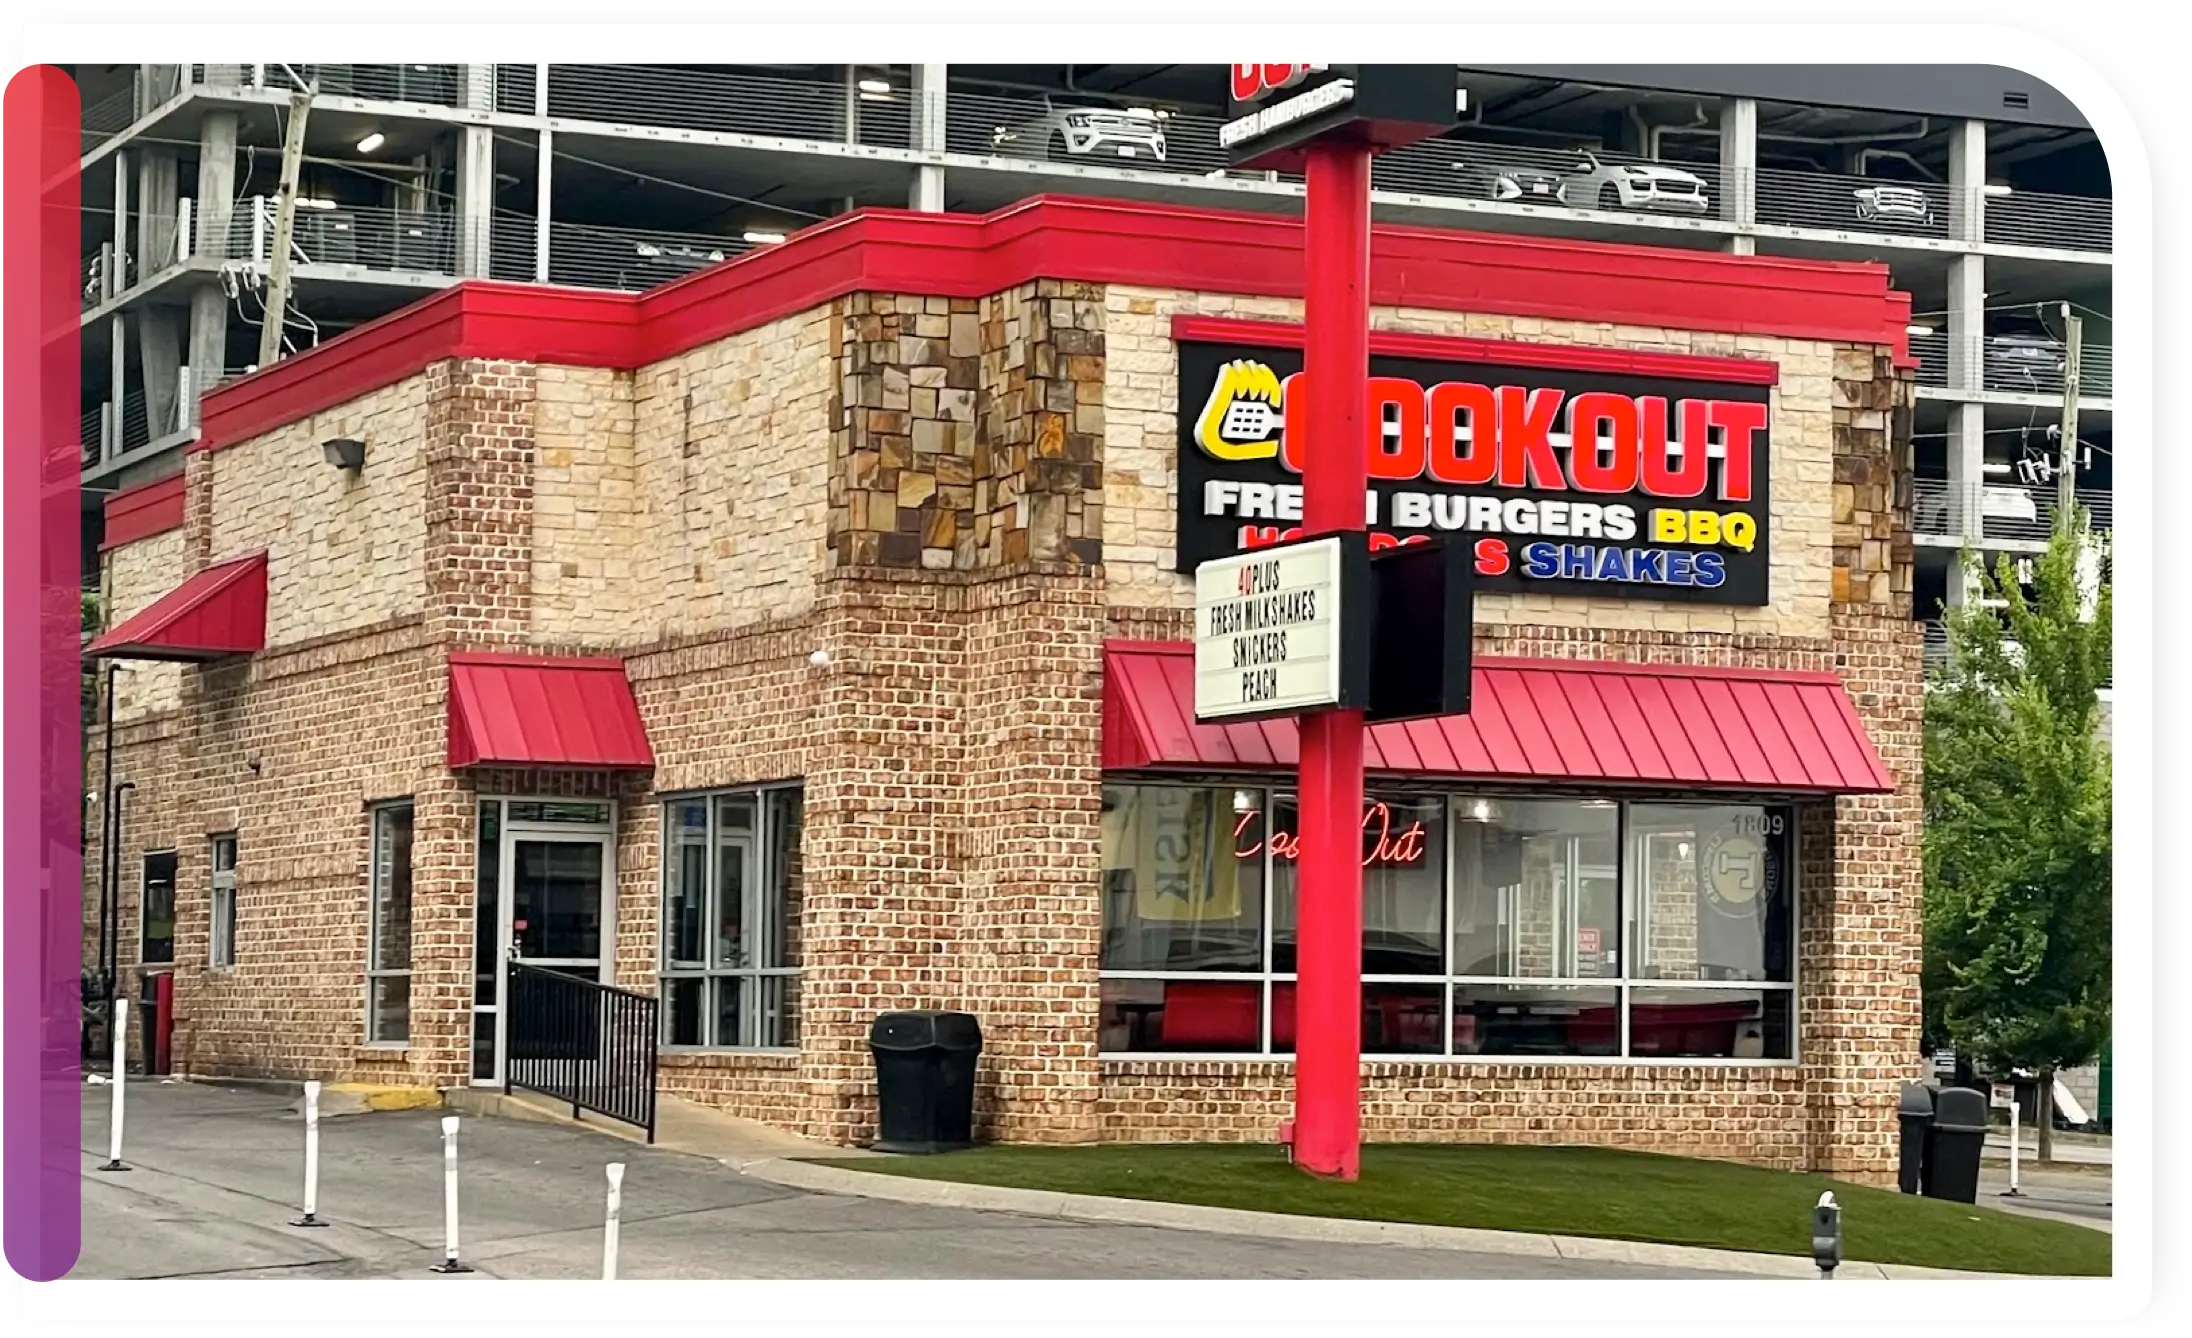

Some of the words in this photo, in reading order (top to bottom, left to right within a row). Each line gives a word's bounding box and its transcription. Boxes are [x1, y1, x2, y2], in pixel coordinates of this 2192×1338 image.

[1204, 480, 1378, 525] FRE
[1392, 491, 1637, 542] BURGERS
[1648, 508, 1756, 553] BBQ
[1521, 542, 1727, 588] SHAKES
[1211, 603, 1242, 636] FRESH
[1245, 590, 1316, 630] MILKSHAKES
[1233, 630, 1287, 668] SNICKERS
[1243, 668, 1278, 703] PEACH
[1731, 814, 1785, 836] 1809
